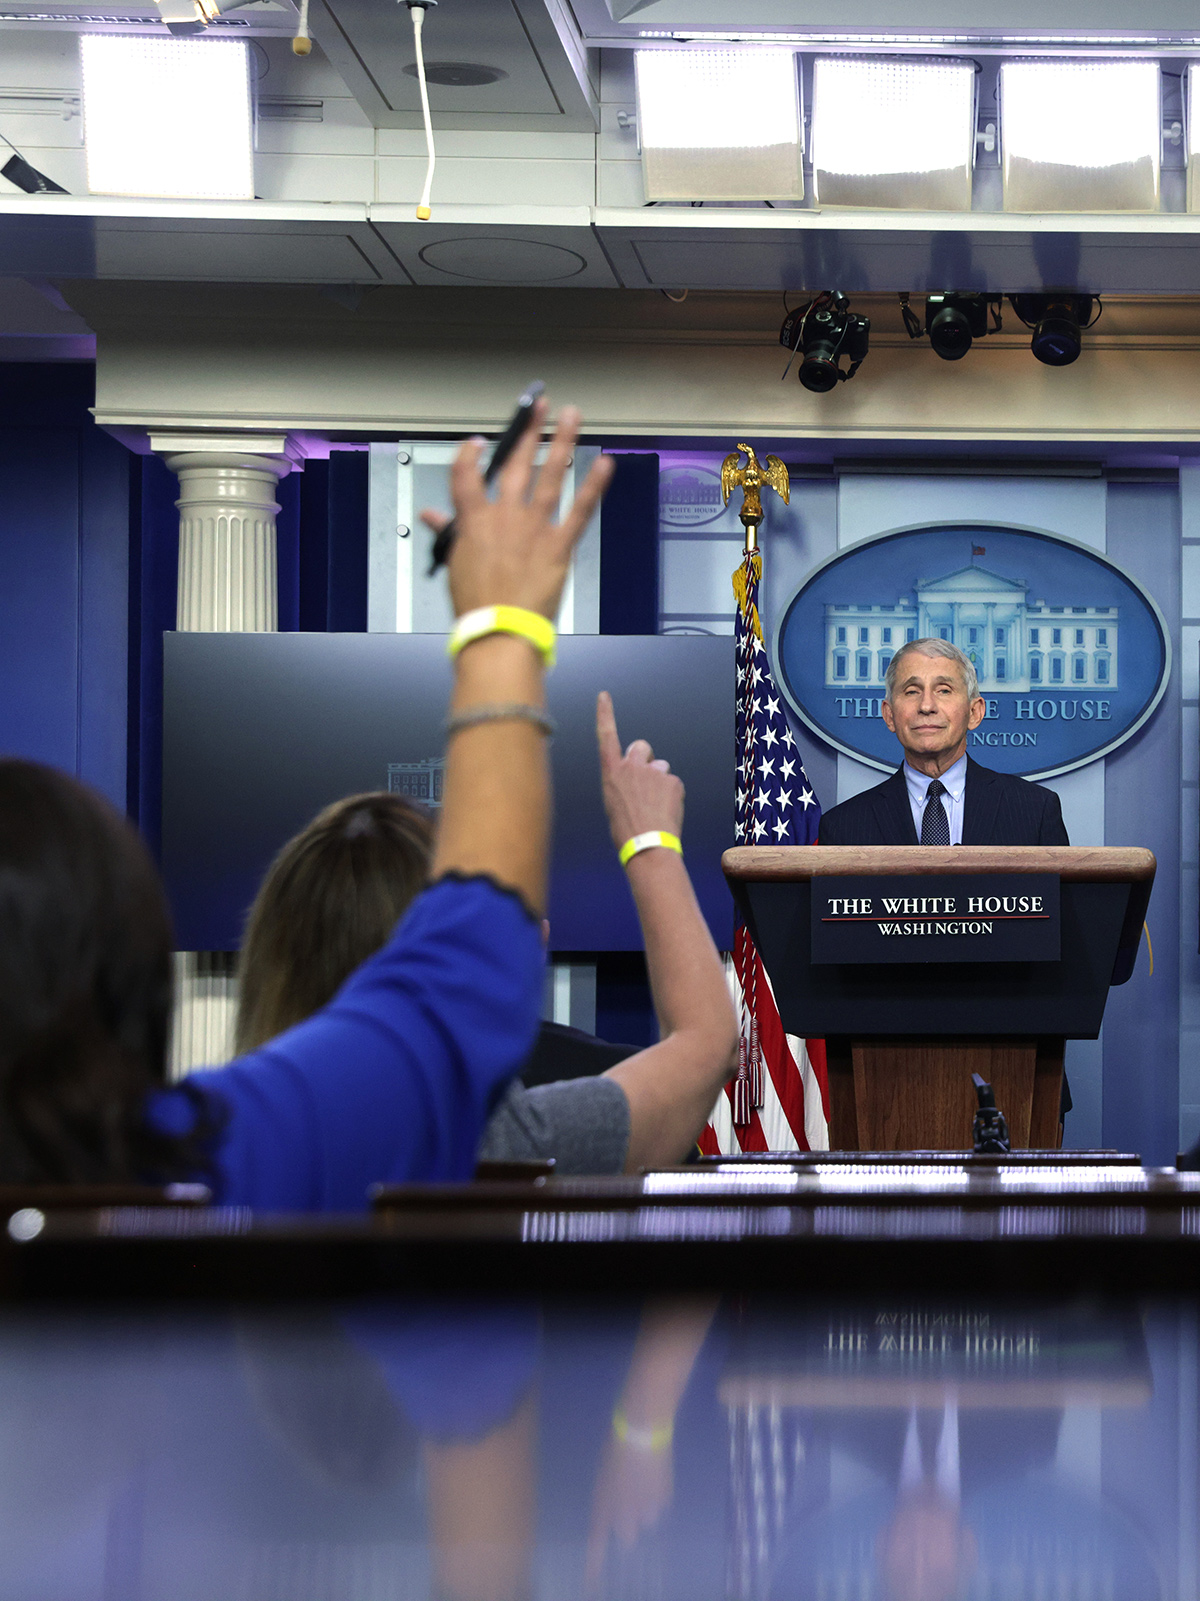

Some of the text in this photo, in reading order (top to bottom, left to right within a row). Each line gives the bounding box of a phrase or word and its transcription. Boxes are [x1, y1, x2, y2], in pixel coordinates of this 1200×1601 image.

[1015, 699, 1112, 720] HOUSE
[828, 896, 1044, 915] THE WHITE HOUSE
[877, 922, 993, 935] WASHINGTON
